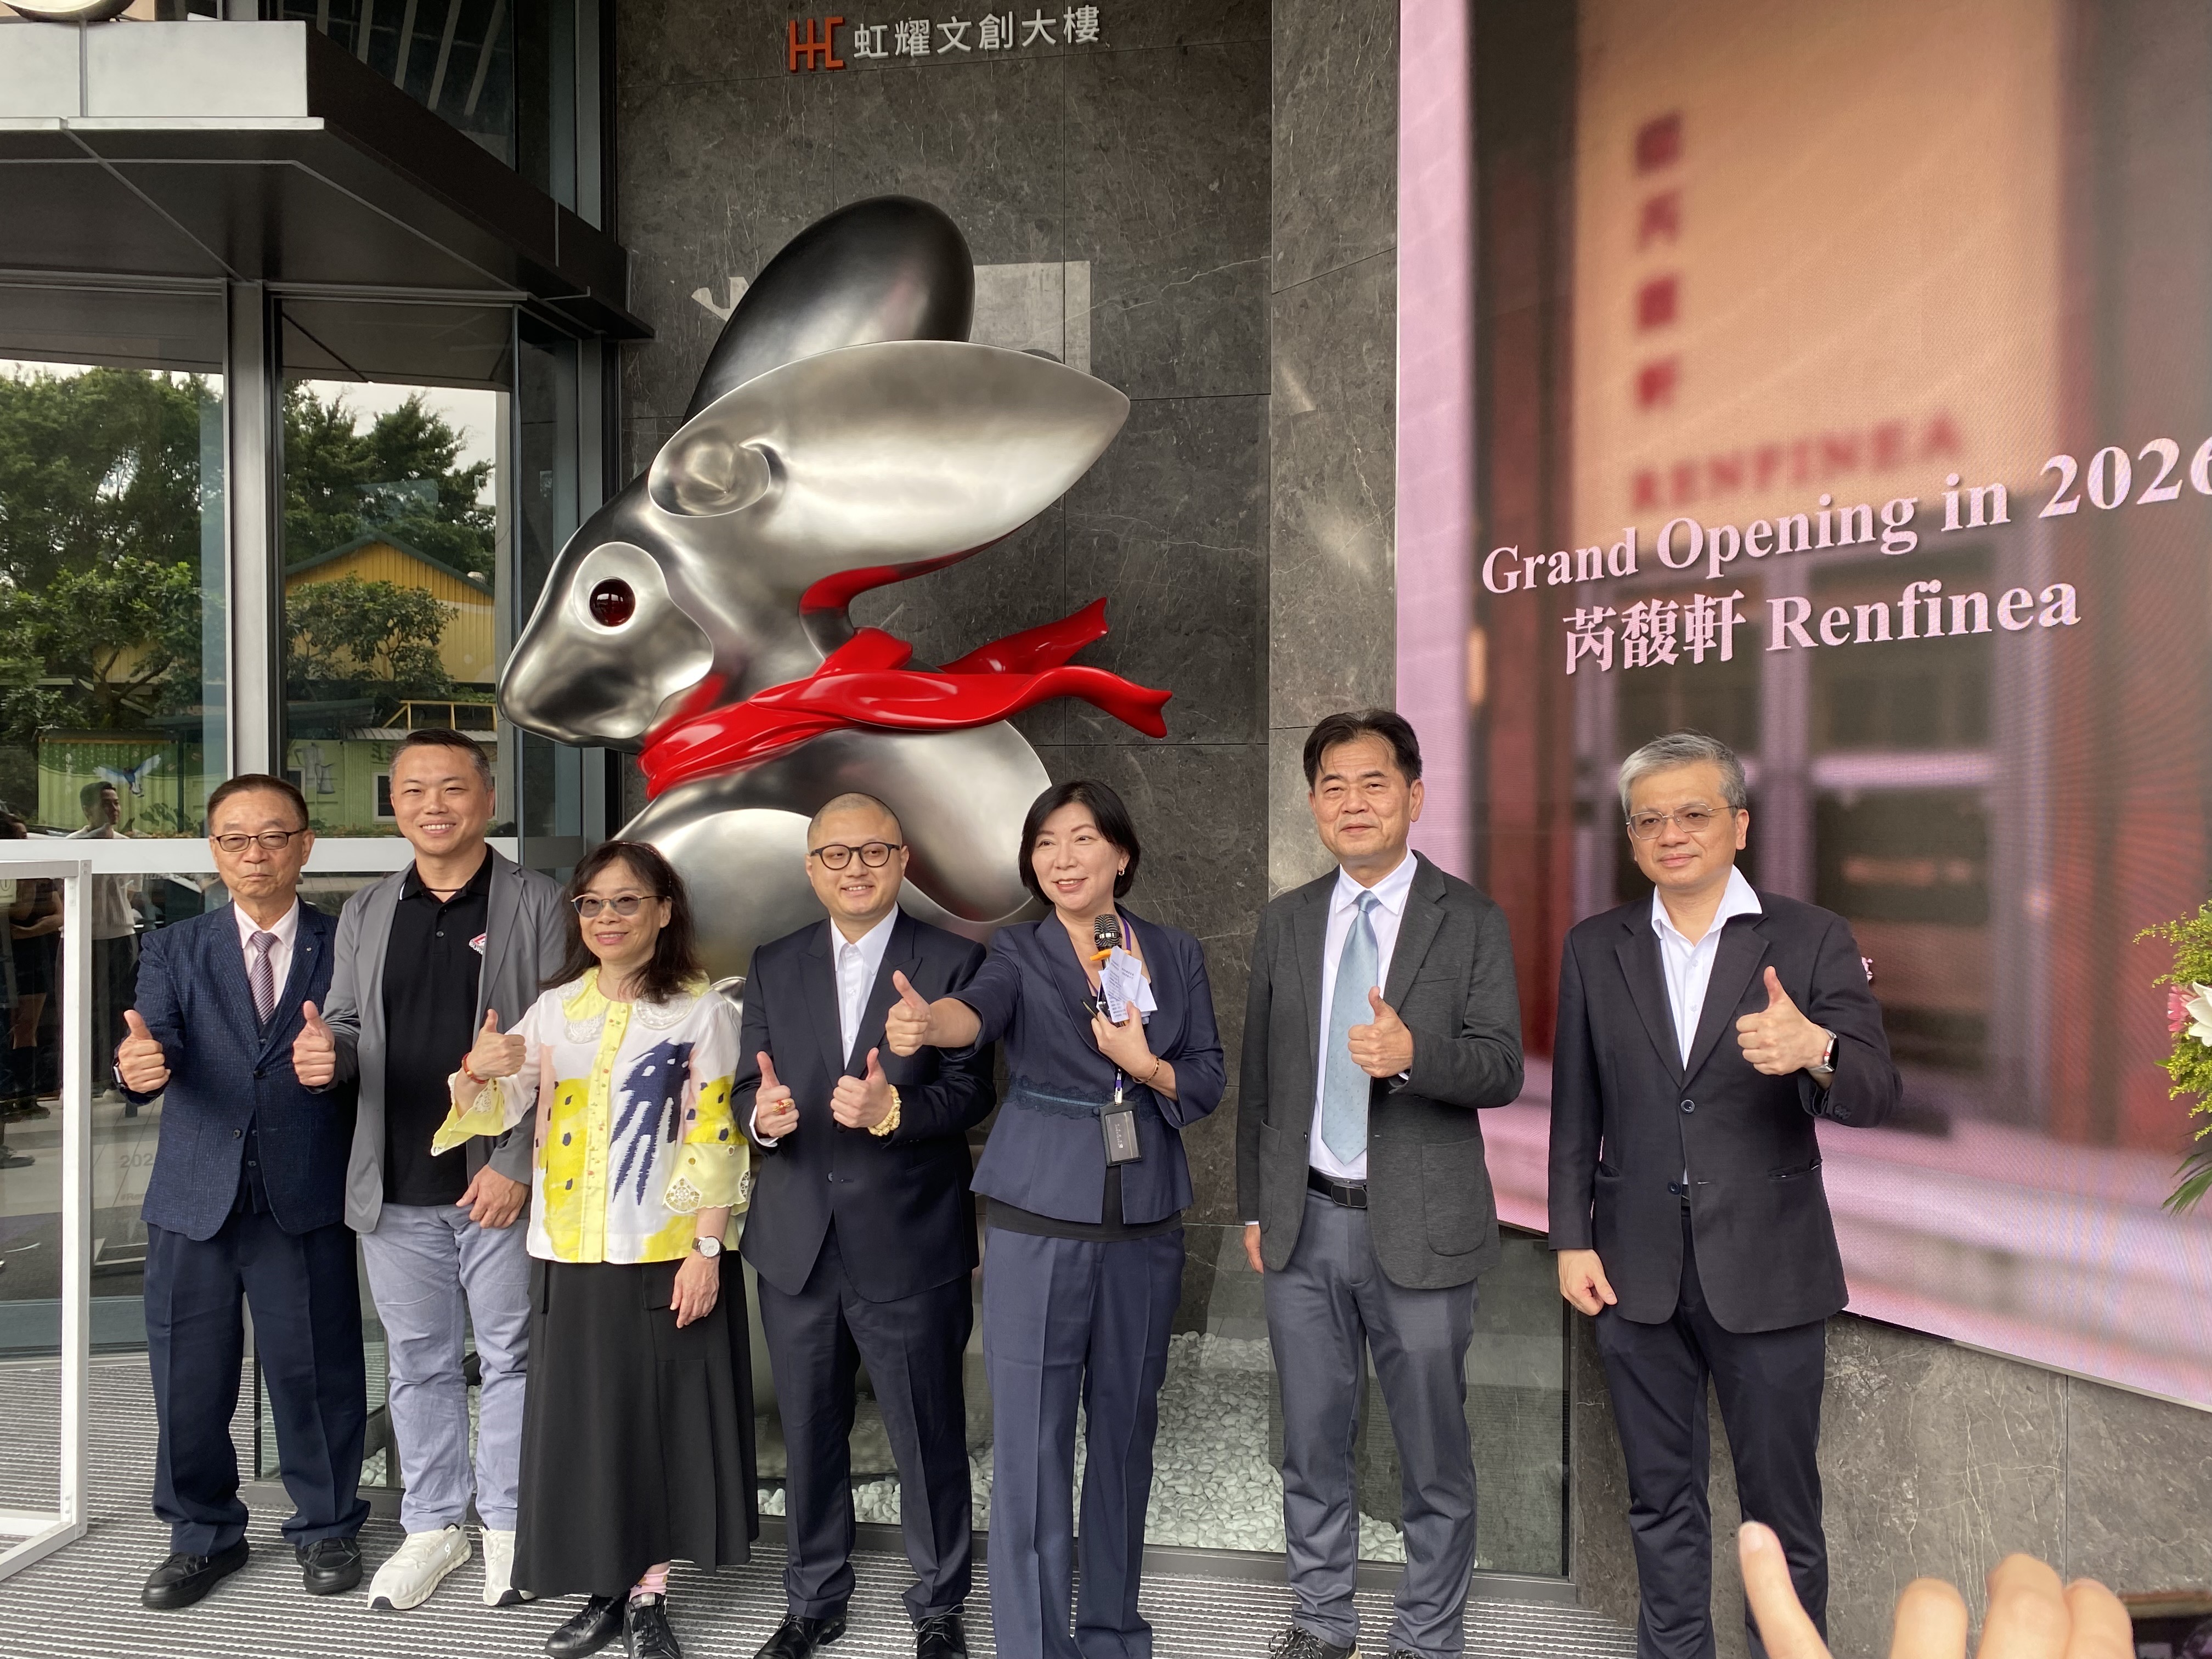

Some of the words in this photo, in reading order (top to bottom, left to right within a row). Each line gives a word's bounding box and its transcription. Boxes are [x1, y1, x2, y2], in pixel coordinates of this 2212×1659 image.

[854, 4, 1099, 59] 虹耀文創大樓
[1482, 527, 1639, 594] Grand
[1657, 494, 1918, 579] Opening
[1940, 473, 2011, 532] in
[1563, 589, 1746, 675] 芮馥軒
[1766, 579, 2081, 651] Renfinea
